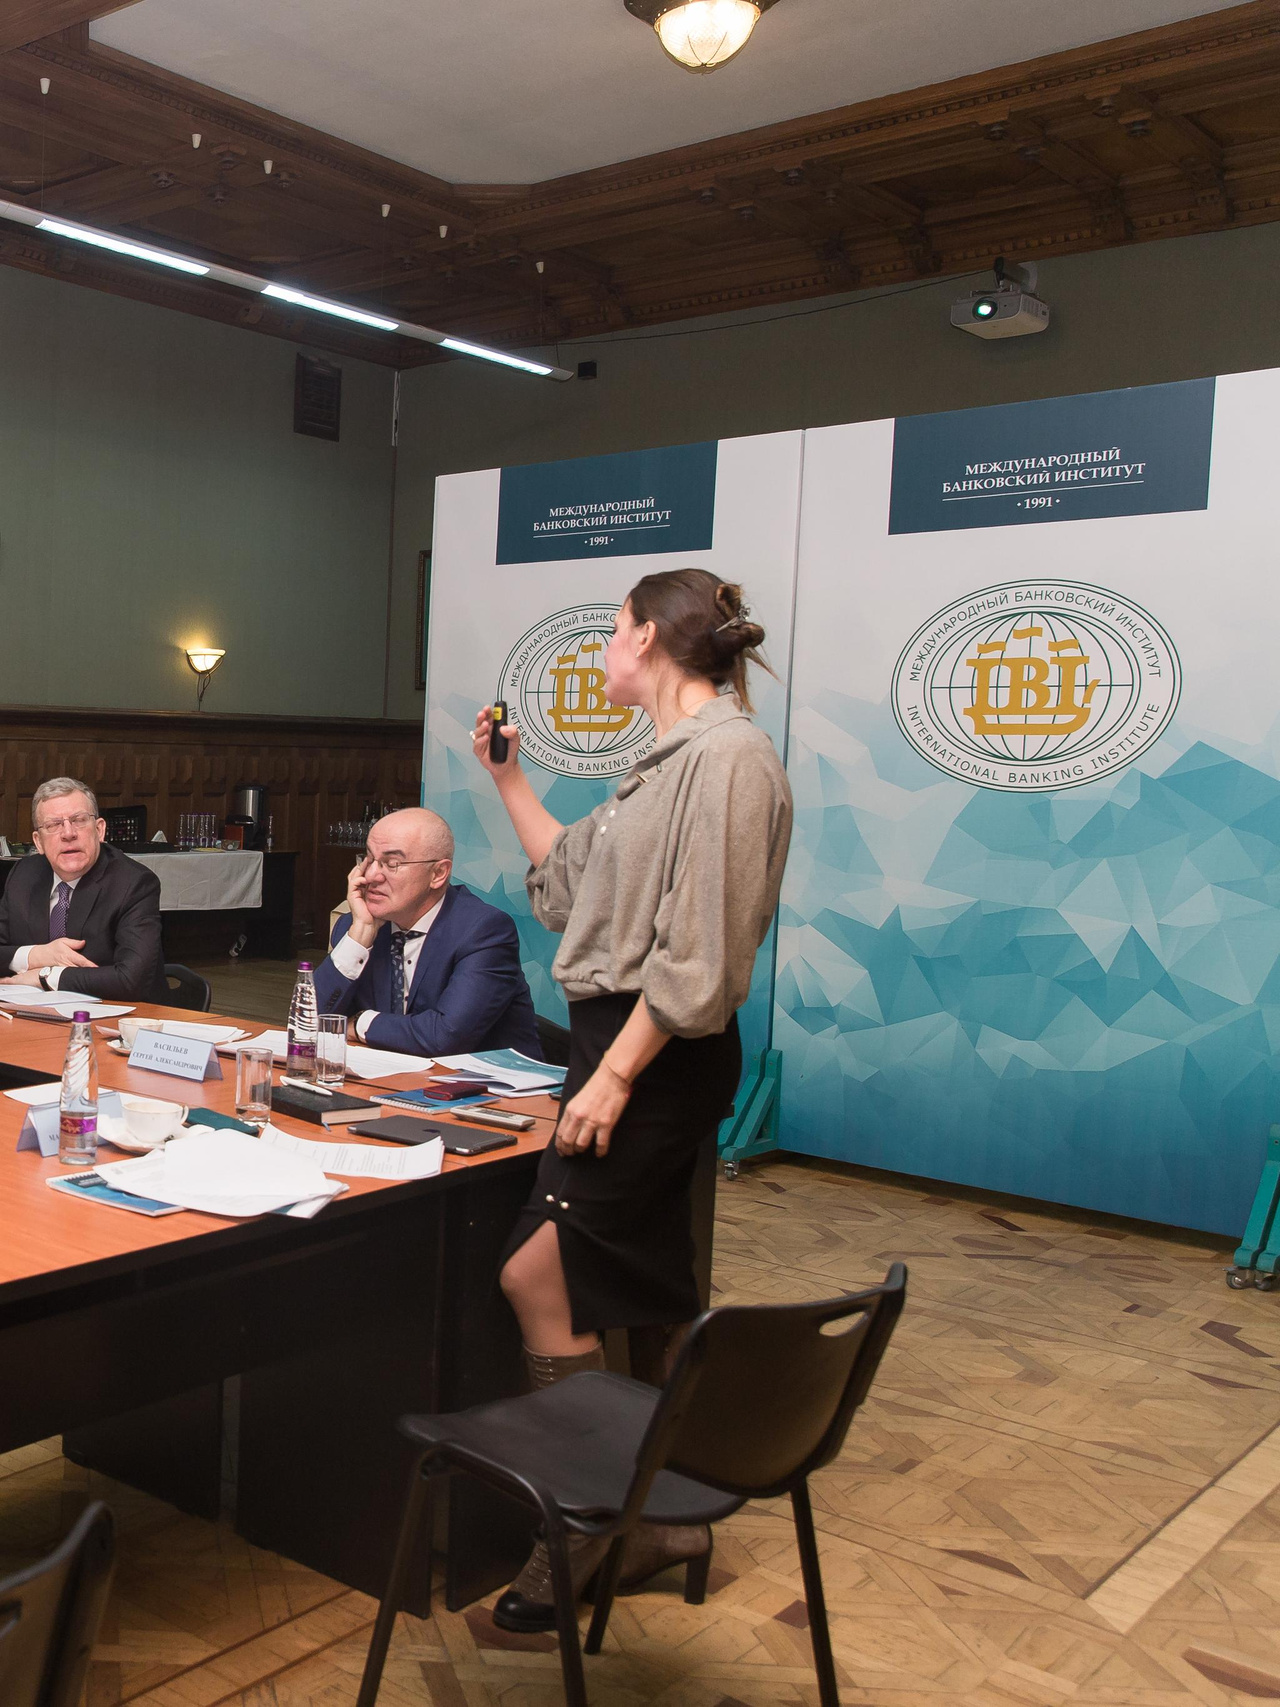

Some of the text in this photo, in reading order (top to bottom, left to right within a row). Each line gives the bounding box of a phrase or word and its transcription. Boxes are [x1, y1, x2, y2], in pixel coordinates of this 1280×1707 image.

[964, 446, 1122, 476] МЕЖДУНАРОДНЫЙ
[942, 462, 1146, 493] БАНКОВСКИЙ ИНСТИТУТ
[533, 510, 672, 532] БАНКОВСКИЙ ИНСТИТУТ
[549, 496, 656, 518] МЕЖДУНАРОДНЫЙ
[510, 612, 617, 687] МЕЖДУНАРОДНЫЙ БАНКО
[909, 590, 1162, 682] МЕЖДУНАРОДНЫЙ БАНКОВСКИЙ ИНСТИТУТ
[509, 706, 572, 770] INTERNATIONAL
[577, 756, 630, 772] BANKING
[906, 703, 1160, 784] INTERNATIONAL BANKING INSTITUTE
[132, 1051, 202, 1071] СЕРГЕЙ АЛЕКСАНДРОВИЧ
[153, 1041, 189, 1055] ВАСИЛЬЕВ
